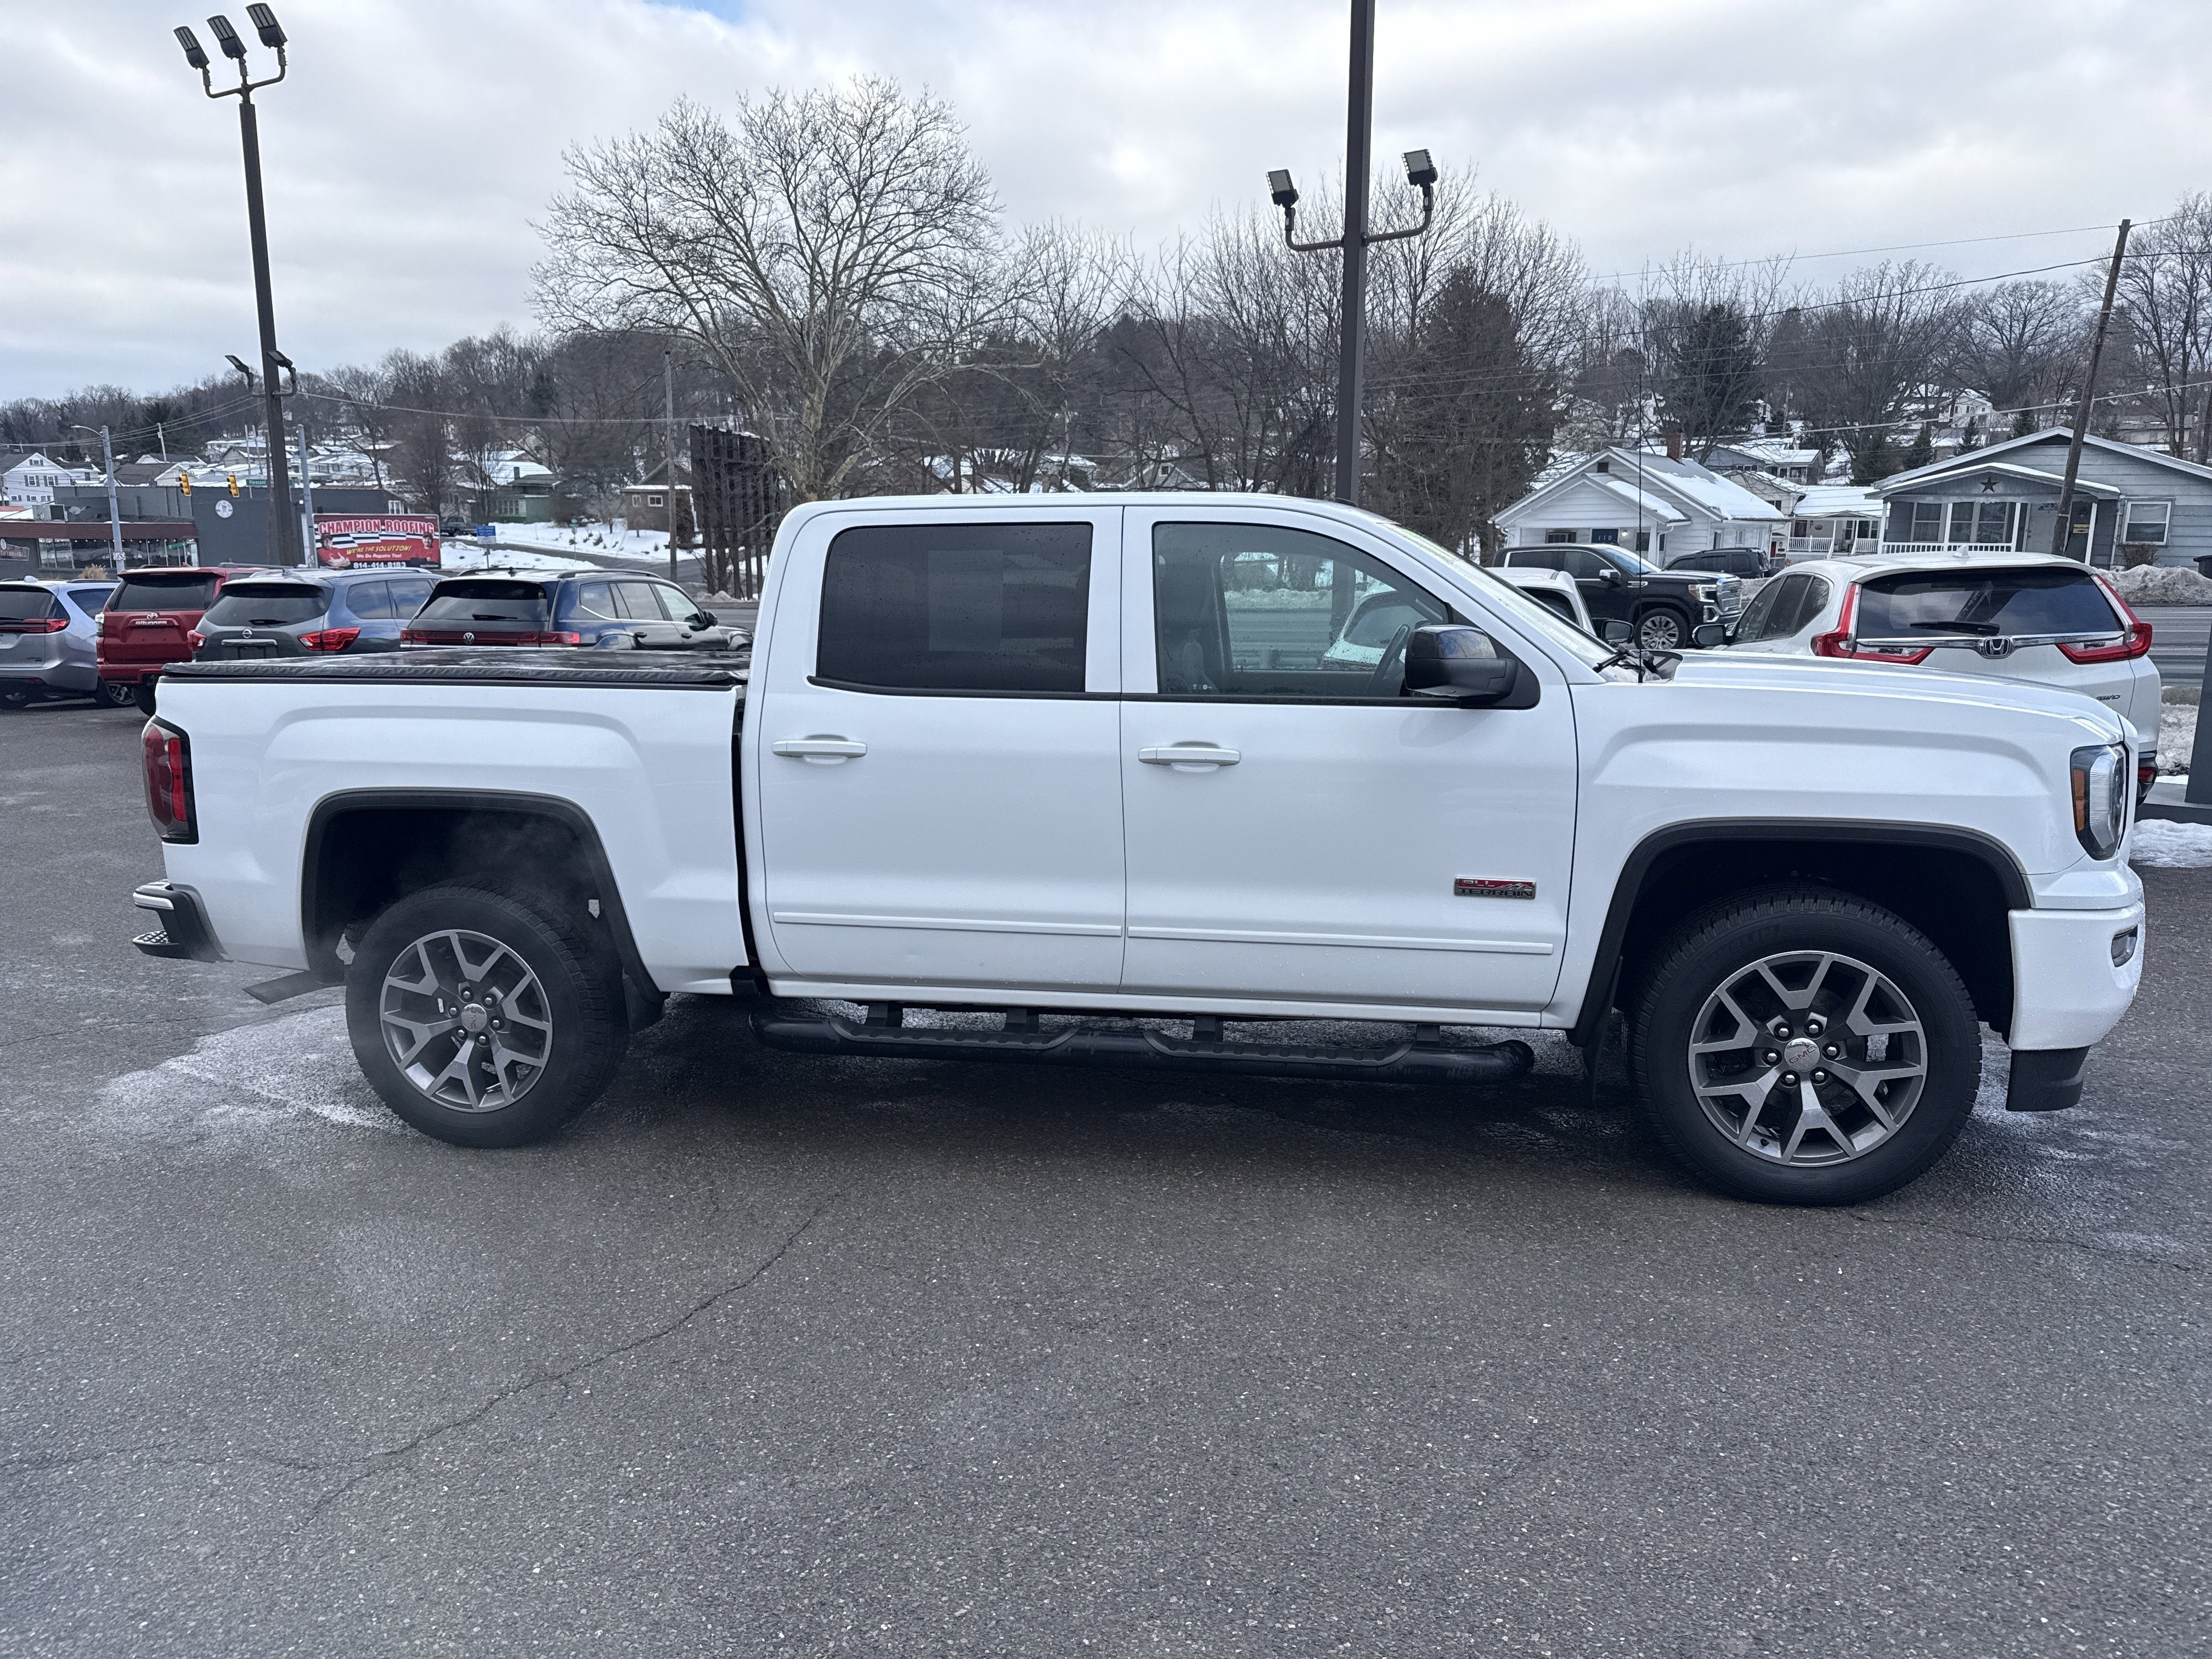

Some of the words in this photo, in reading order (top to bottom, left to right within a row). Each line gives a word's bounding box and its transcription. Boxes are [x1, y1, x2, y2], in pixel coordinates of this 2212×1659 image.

[318, 519, 381, 535] CHAMPION
[385, 520, 434, 535] ROOFING
[1458, 889, 1533, 898] TERRAIN
[1788, 1045, 1817, 1064] GMC
